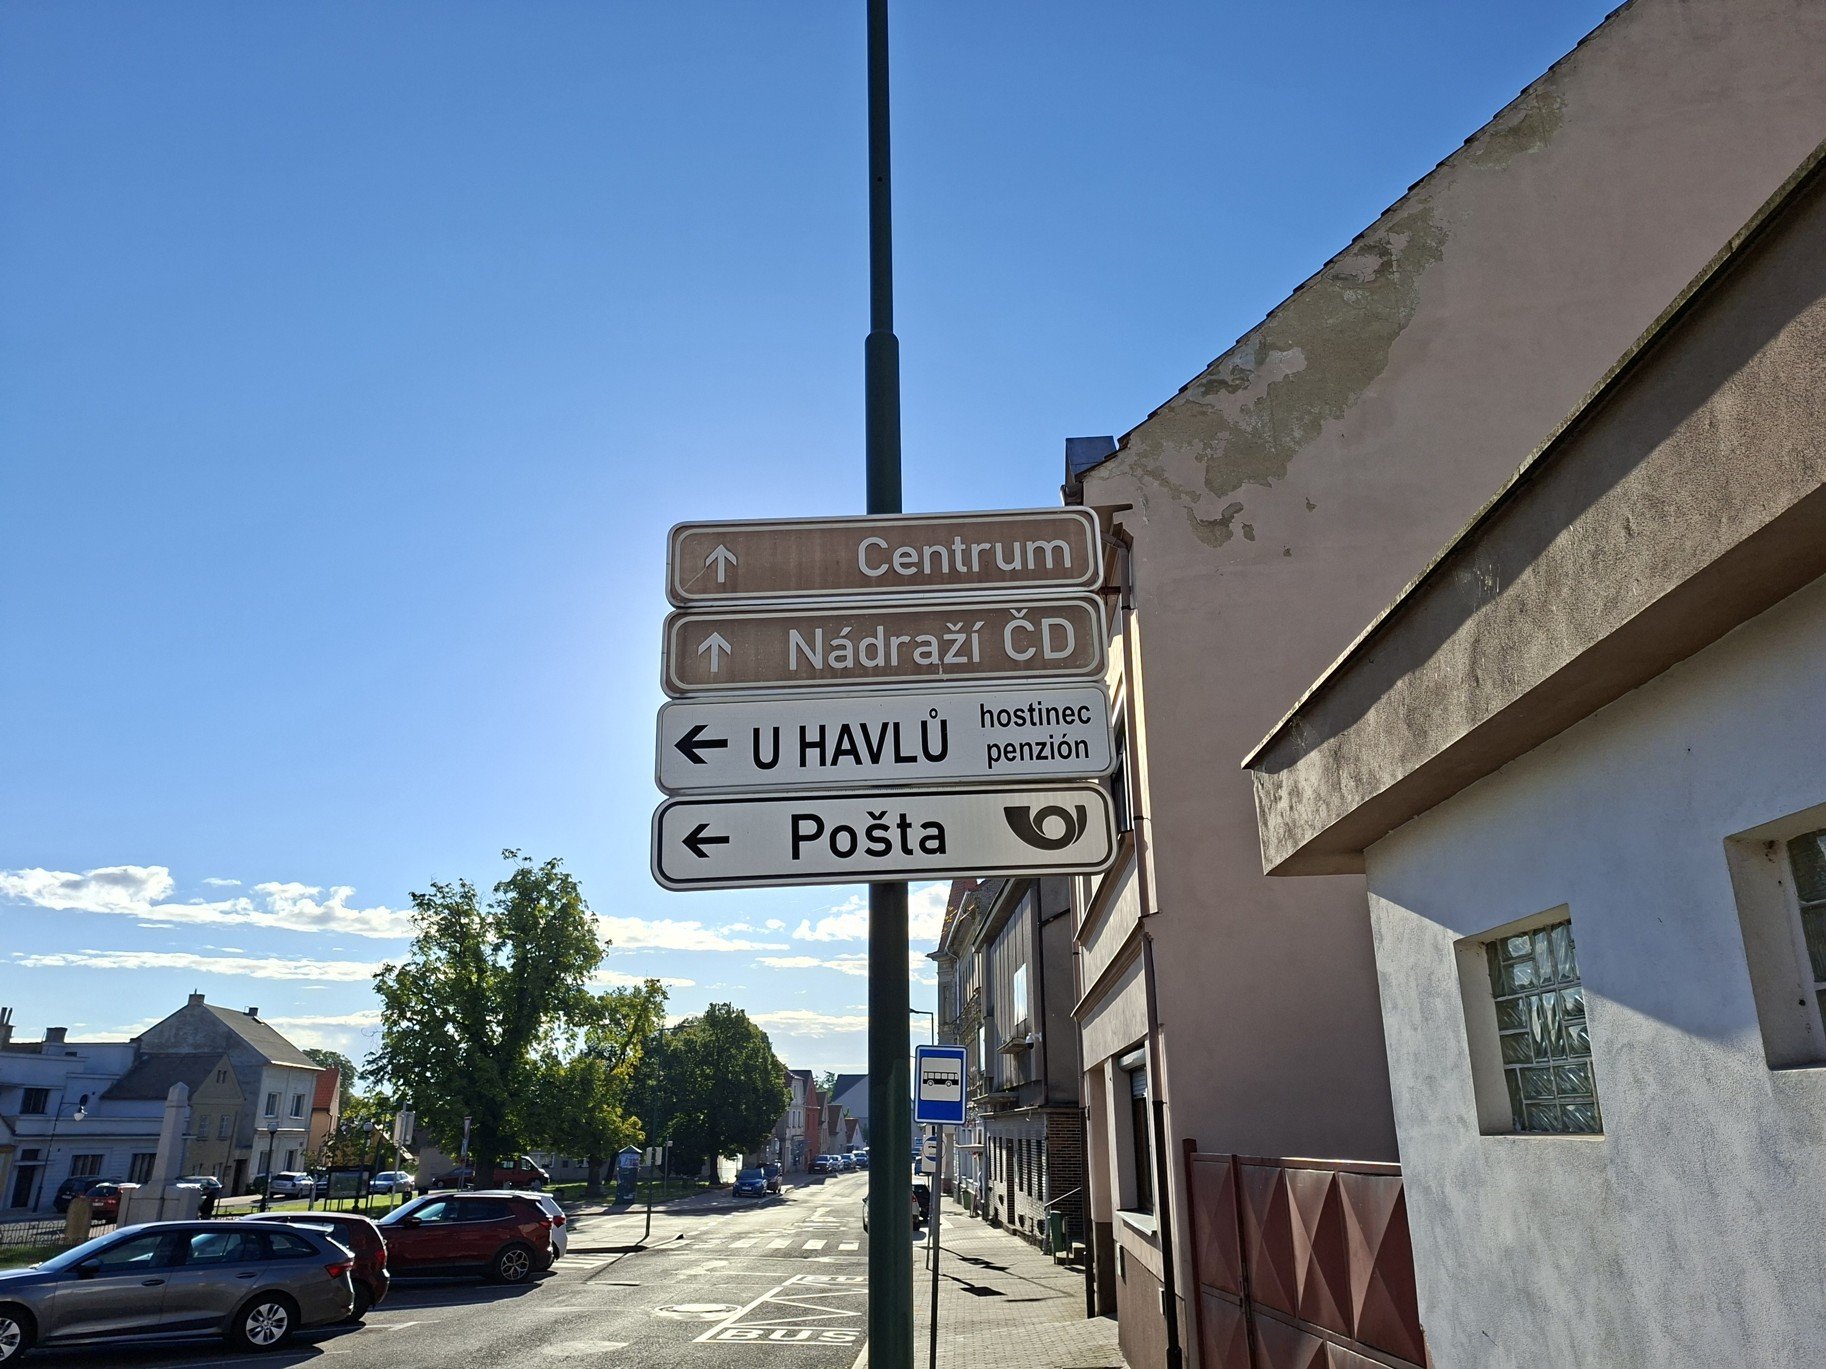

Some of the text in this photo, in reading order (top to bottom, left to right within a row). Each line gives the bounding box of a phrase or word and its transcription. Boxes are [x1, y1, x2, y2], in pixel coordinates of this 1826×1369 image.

[857, 536, 1071, 576] Centrum
[788, 609, 1075, 671] Nádraží ČD
[980, 701, 1092, 728] hostinec
[752, 708, 949, 770] U HAVLŮ
[986, 733, 1090, 769] penzión
[791, 810, 947, 860] Pošta
[716, 1328, 859, 1342] BUS
